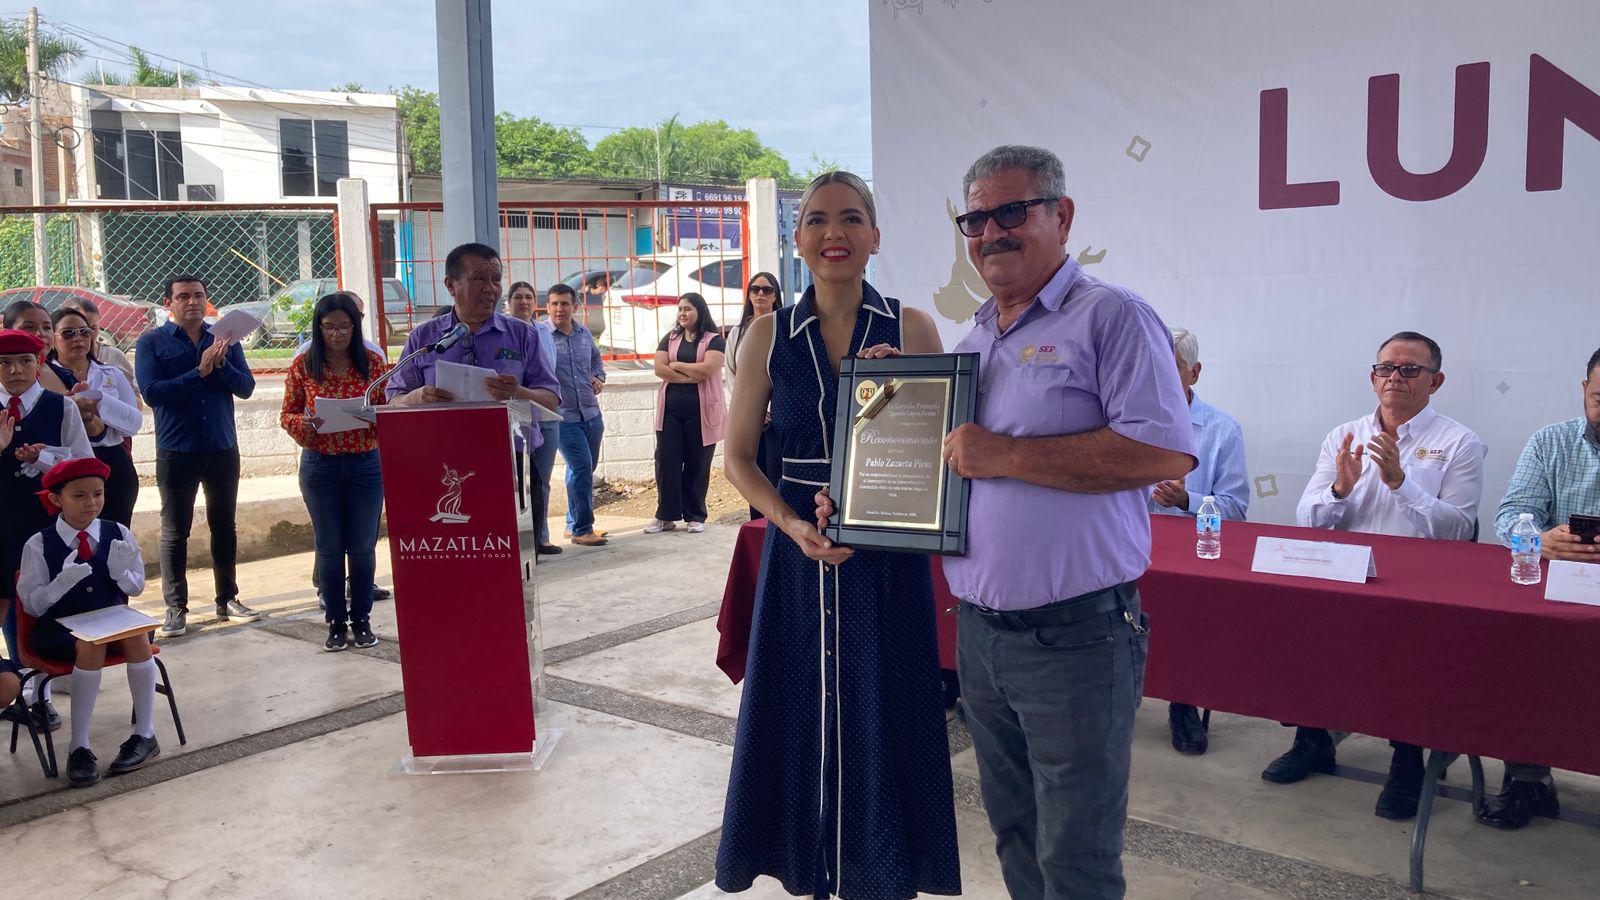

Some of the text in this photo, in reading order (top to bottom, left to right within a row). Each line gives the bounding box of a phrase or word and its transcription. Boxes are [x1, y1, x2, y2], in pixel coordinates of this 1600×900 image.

[865, 457, 885, 467] Pablo
[885, 458, 912, 468] Zazueta
[399, 532, 511, 552] MAZATLÁN
